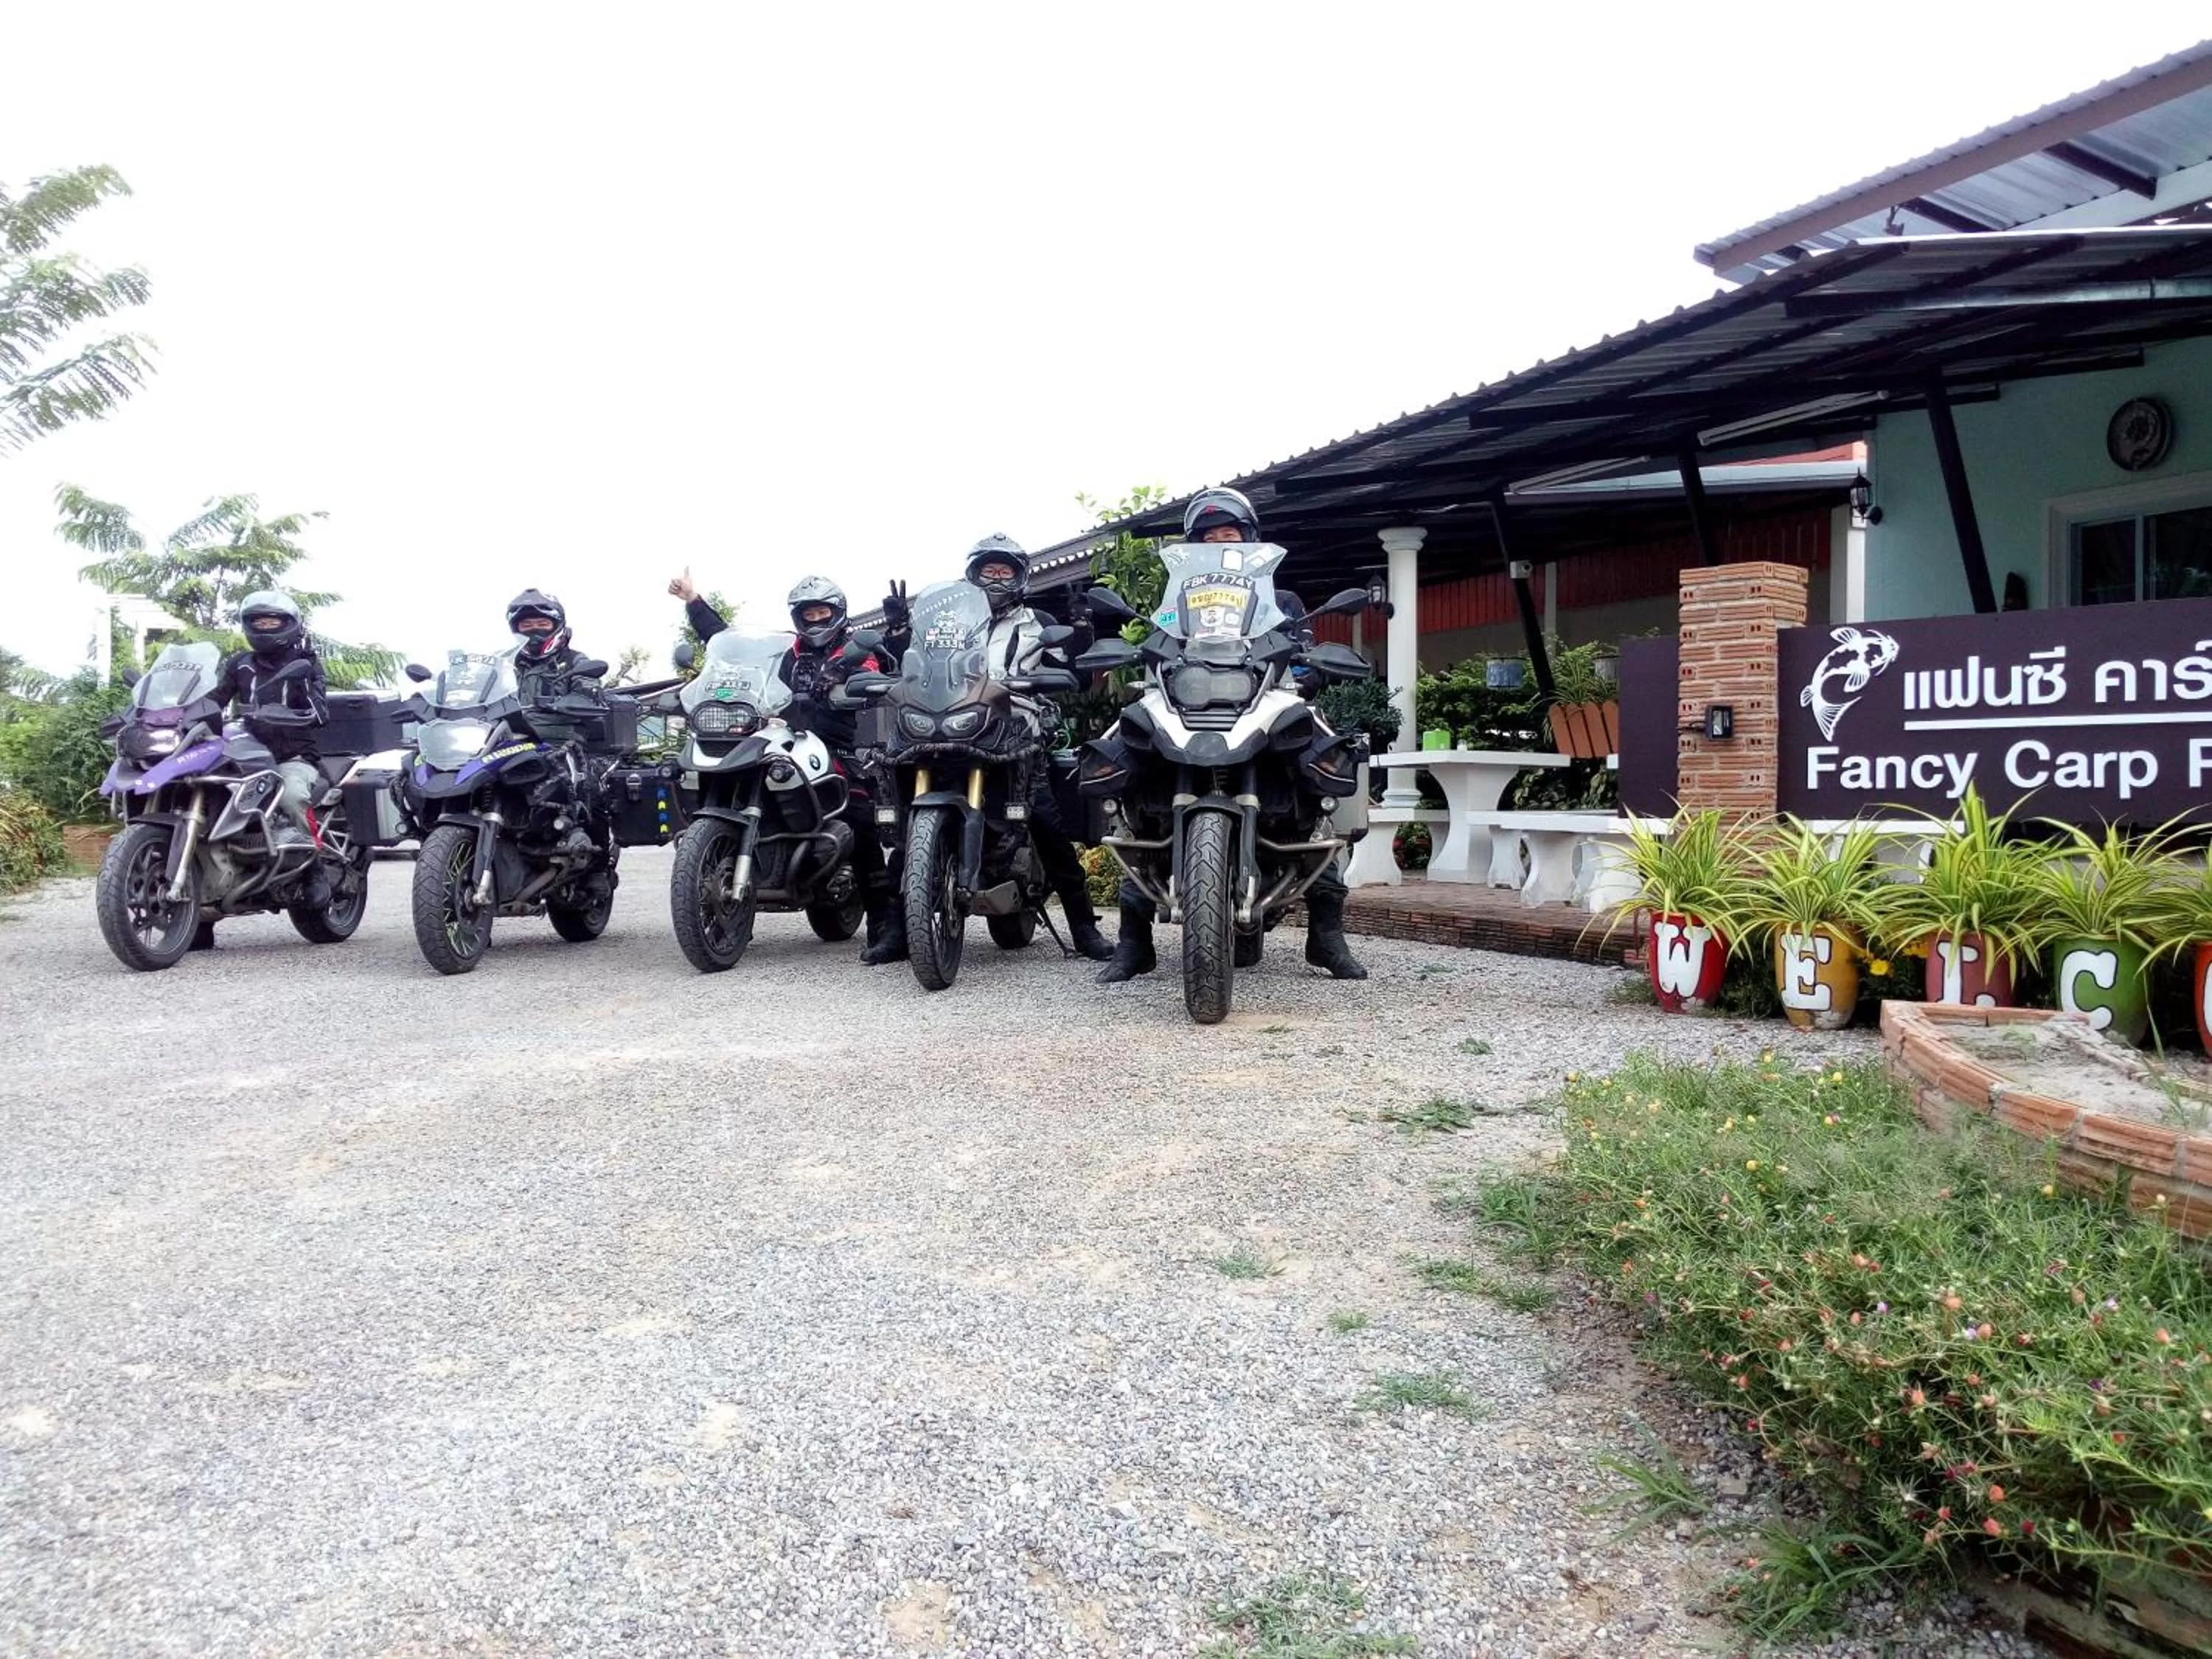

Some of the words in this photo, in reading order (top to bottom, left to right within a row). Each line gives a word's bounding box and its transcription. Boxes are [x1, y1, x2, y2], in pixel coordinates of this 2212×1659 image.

[1904, 645, 2067, 710] แฟนซี
[1807, 745, 1979, 799] Fancy
[2004, 740, 2158, 799] Carp
